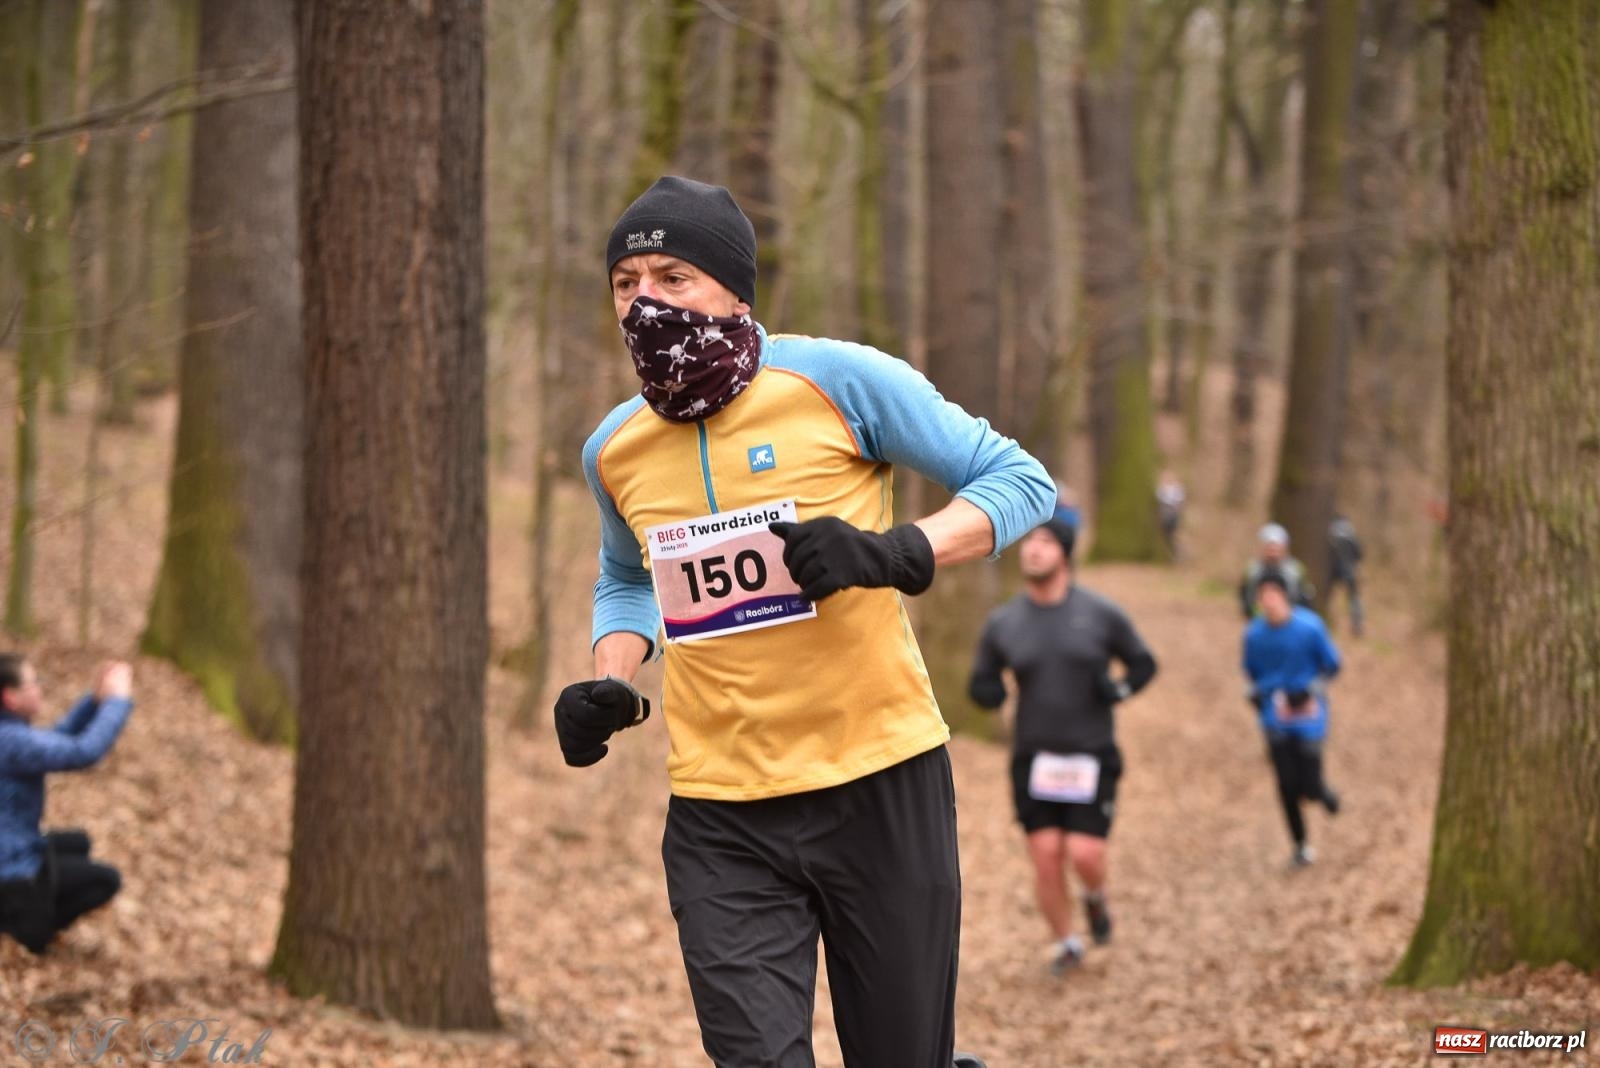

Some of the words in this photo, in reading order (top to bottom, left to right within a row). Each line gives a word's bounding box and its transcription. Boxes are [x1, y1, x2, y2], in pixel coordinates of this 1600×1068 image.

[628, 231, 646, 241] Jack
[626, 239, 663, 250] Wolfskin
[657, 527, 686, 543] BIEG
[689, 510, 780, 537] Twardziela
[681, 549, 767, 604] 150
[745, 604, 784, 619] Racibórz
